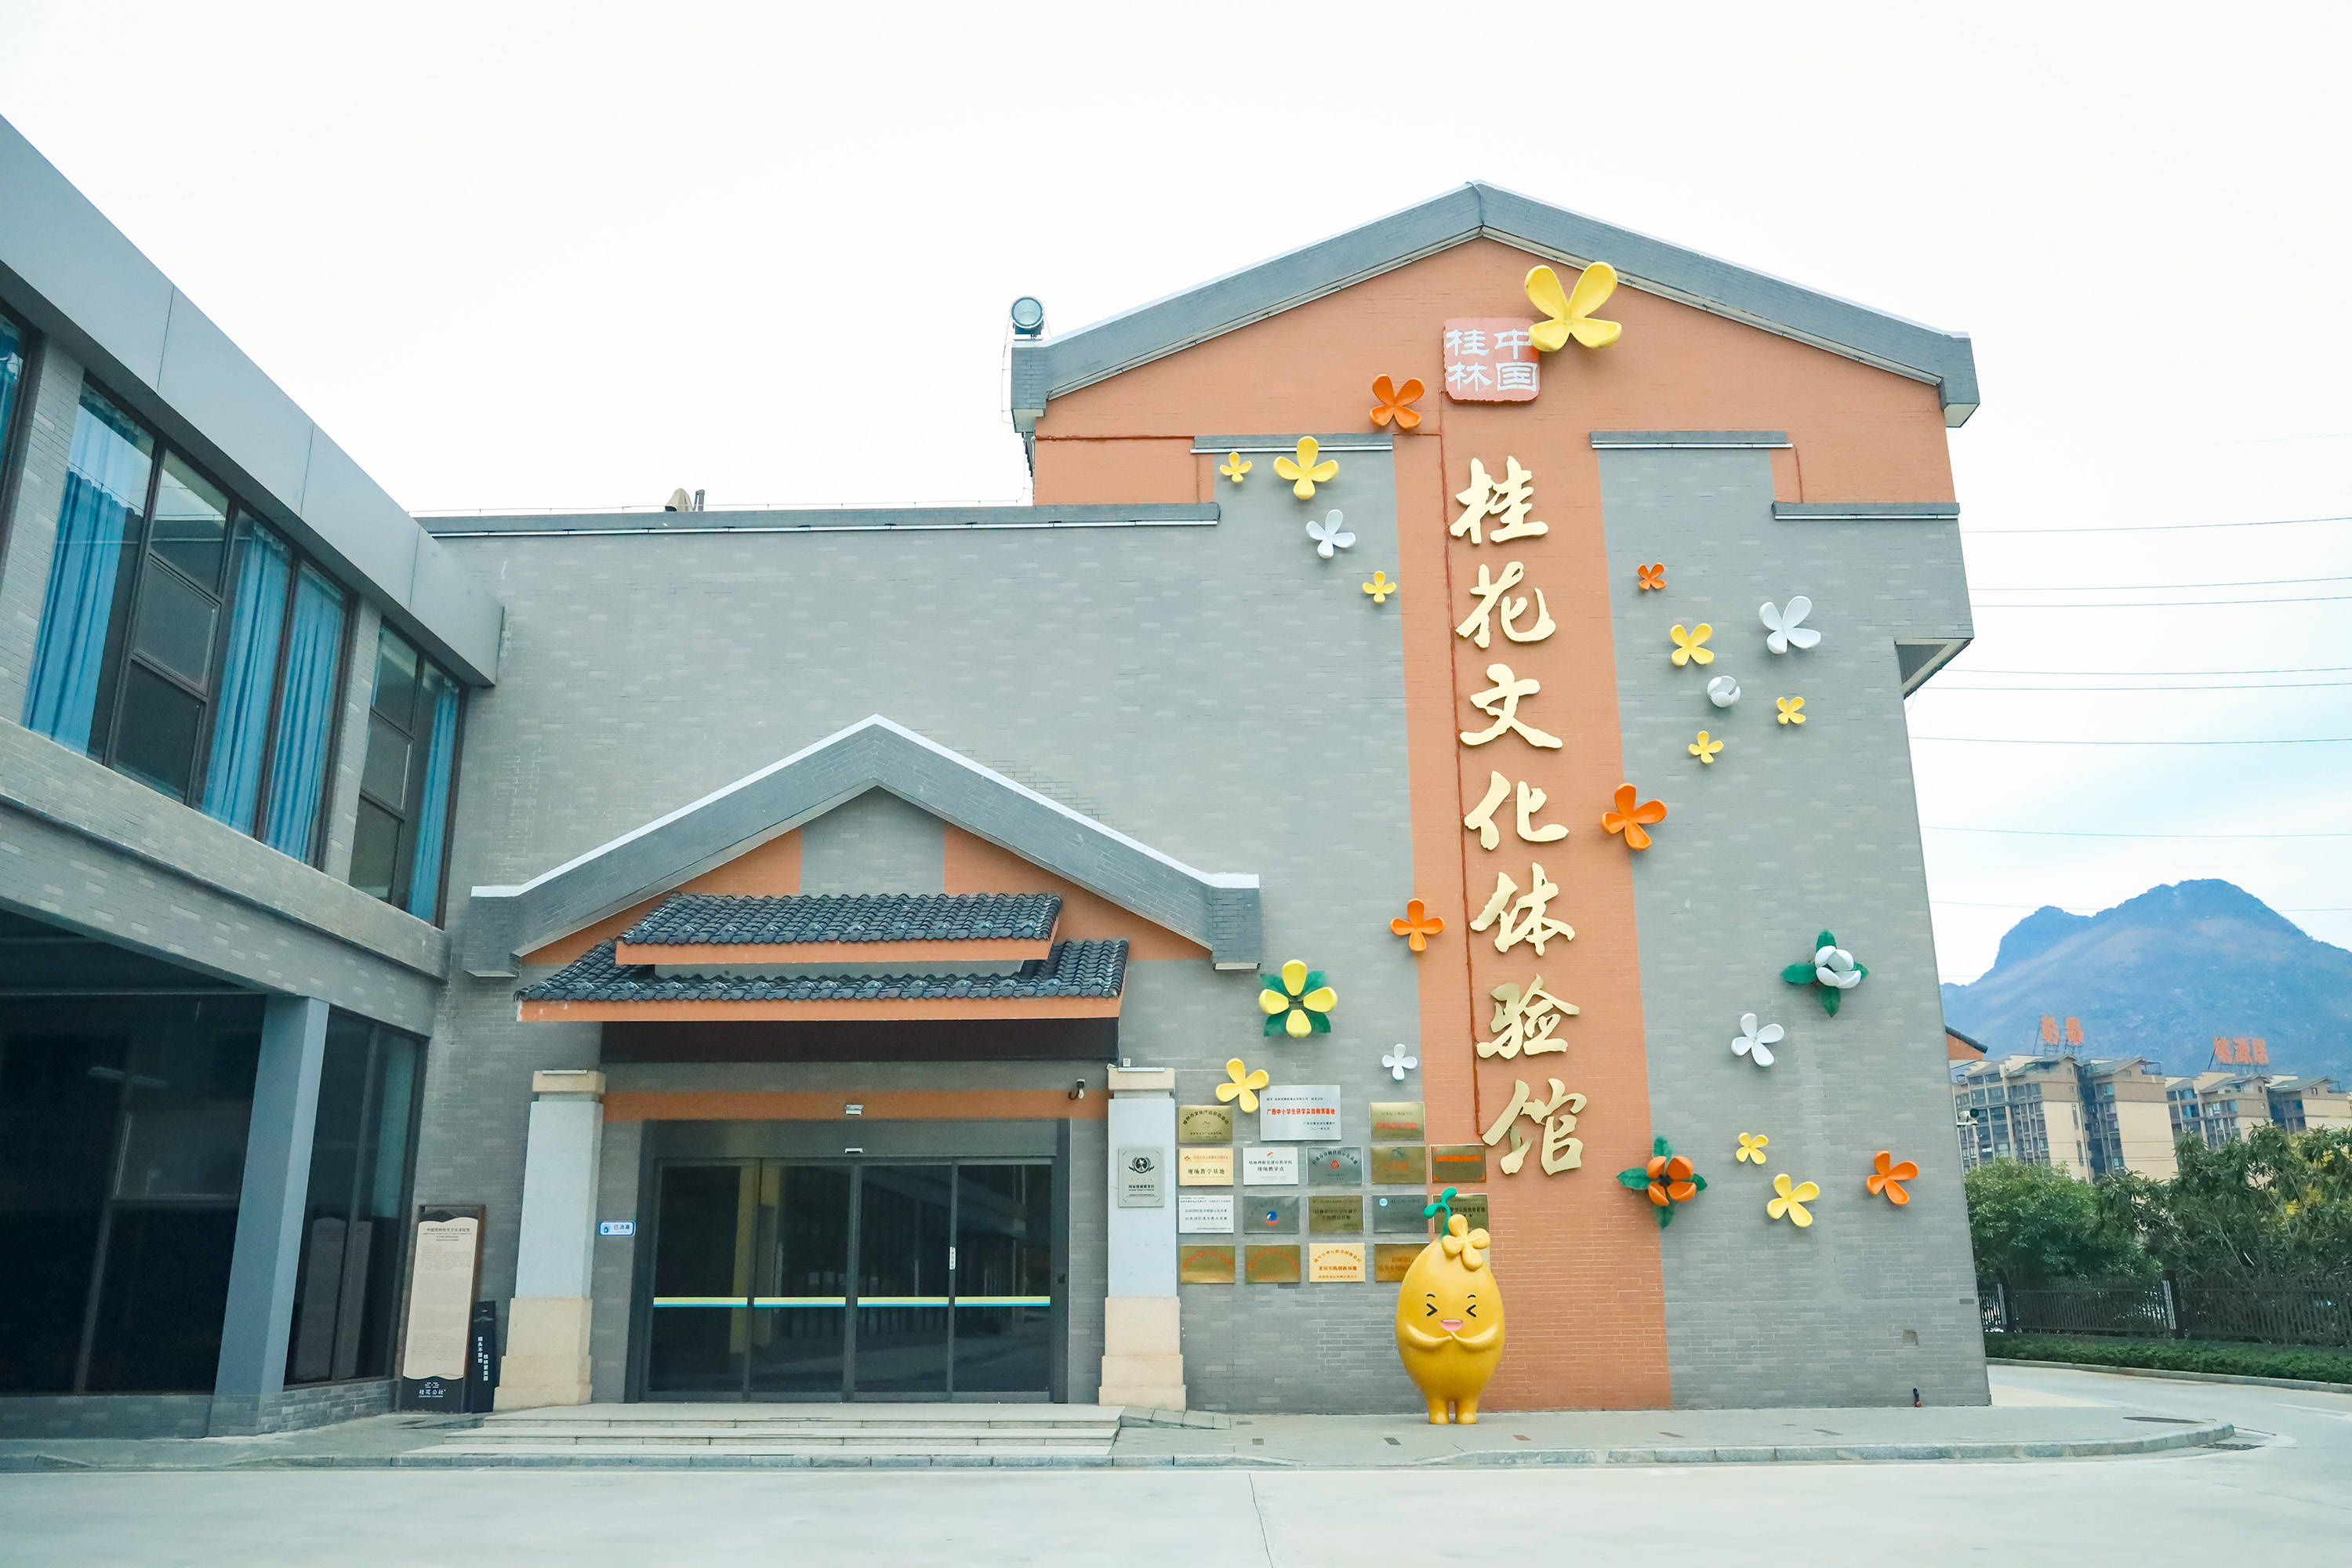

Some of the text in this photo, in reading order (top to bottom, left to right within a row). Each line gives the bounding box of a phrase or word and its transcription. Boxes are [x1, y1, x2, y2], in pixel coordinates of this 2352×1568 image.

[1446, 328, 1493, 391] 桂林
[1494, 328, 1538, 392] 中国
[1450, 456, 1587, 1175] 桂花文化体验馆
